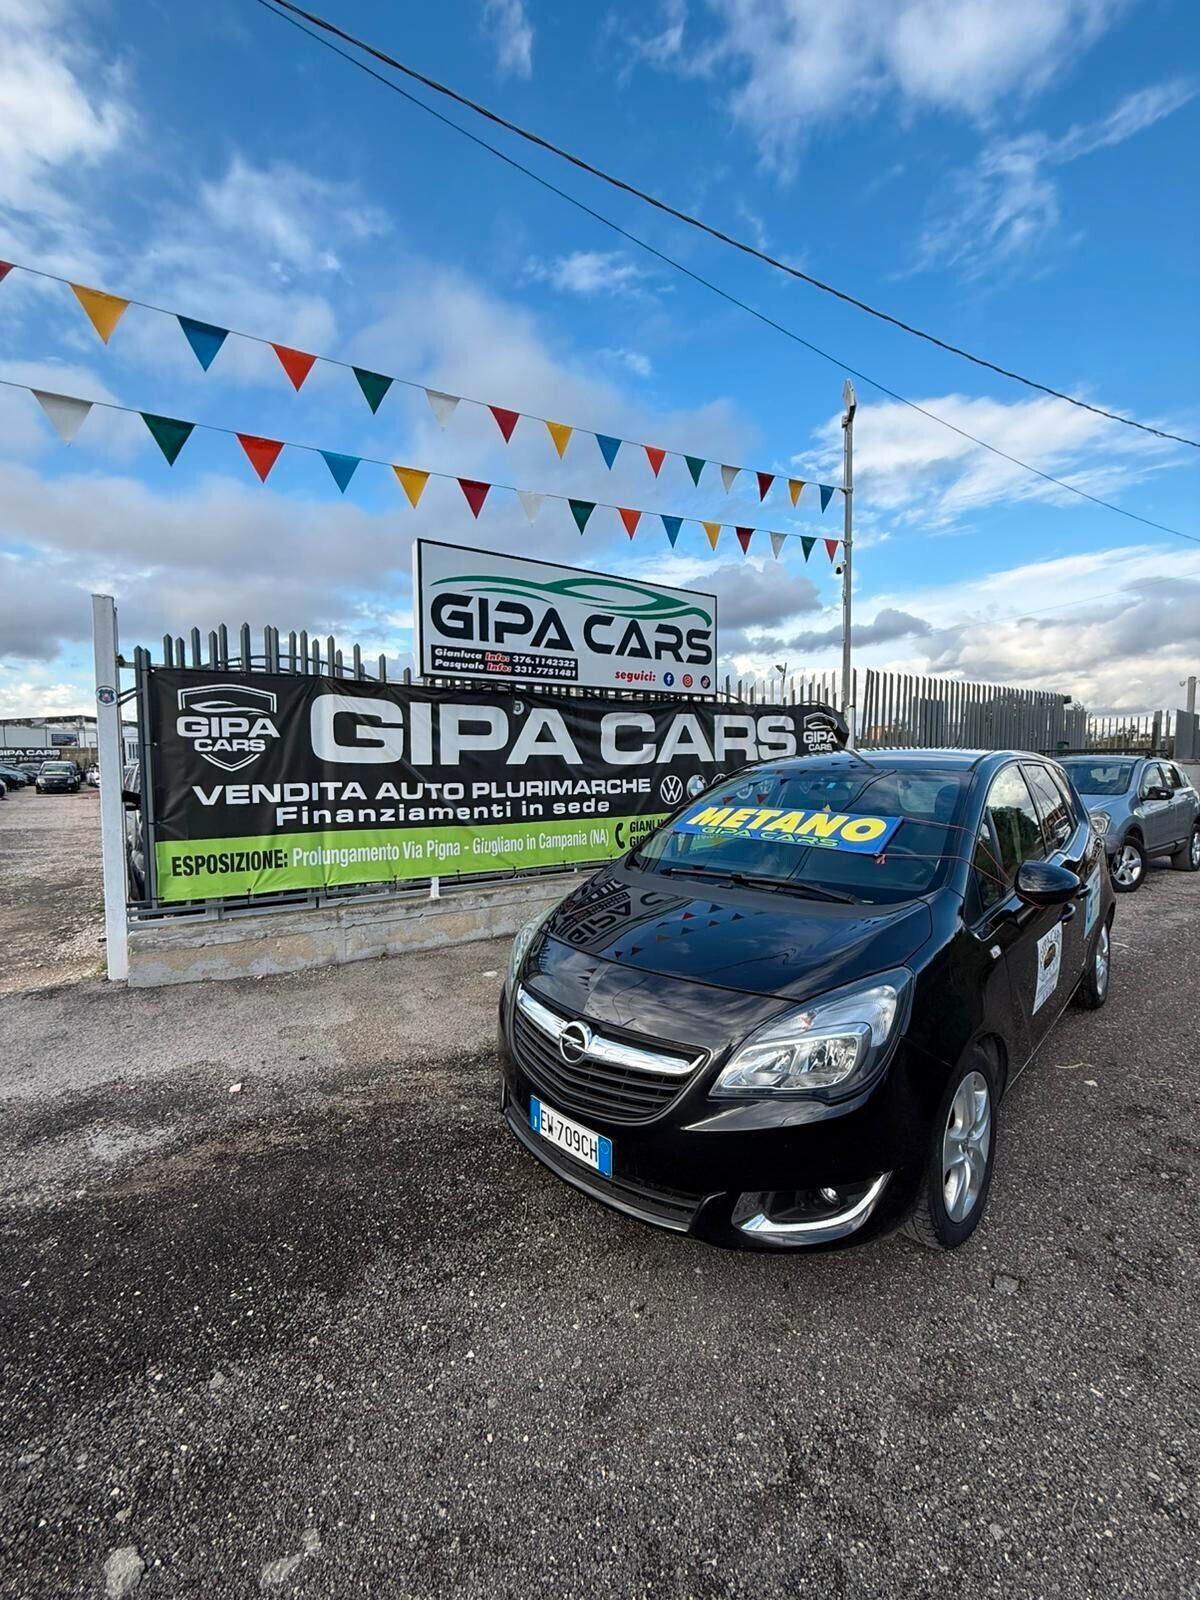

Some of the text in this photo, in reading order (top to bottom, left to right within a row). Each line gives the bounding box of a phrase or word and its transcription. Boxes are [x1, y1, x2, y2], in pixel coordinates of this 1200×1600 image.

[430, 592, 712, 666] GIPA CARS
[434, 647, 576, 668] Gianluca Info: 376.1142322
[434, 658, 576, 677] Pasquale Info: 331.7751481
[614, 669, 657, 683] seguici:
[176, 715, 281, 738] GIPA
[310, 693, 797, 766] GIPA CARS
[803, 730, 838, 744] GIPA
[193, 738, 266, 753] CARS
[808, 743, 833, 752] CARS
[192, 778, 652, 806] VENDITA AUTO PLURIMARCHE
[276, 798, 610, 827] Finanziamenti in sede
[686, 806, 887, 843] METANO
[701, 826, 752, 838] GIPA
[760, 831, 841, 848] CARS
[171, 848, 288, 877] ESPOSIZIONE:
[292, 842, 400, 868] Prolungamento
[402, 840, 423, 860] Via
[426, 839, 461, 861] Pigna
[472, 835, 524, 857] Giugliano
[526, 834, 537, 850] in
[539, 830, 588, 851] Campania
[590, 828, 609, 848] (NA)
